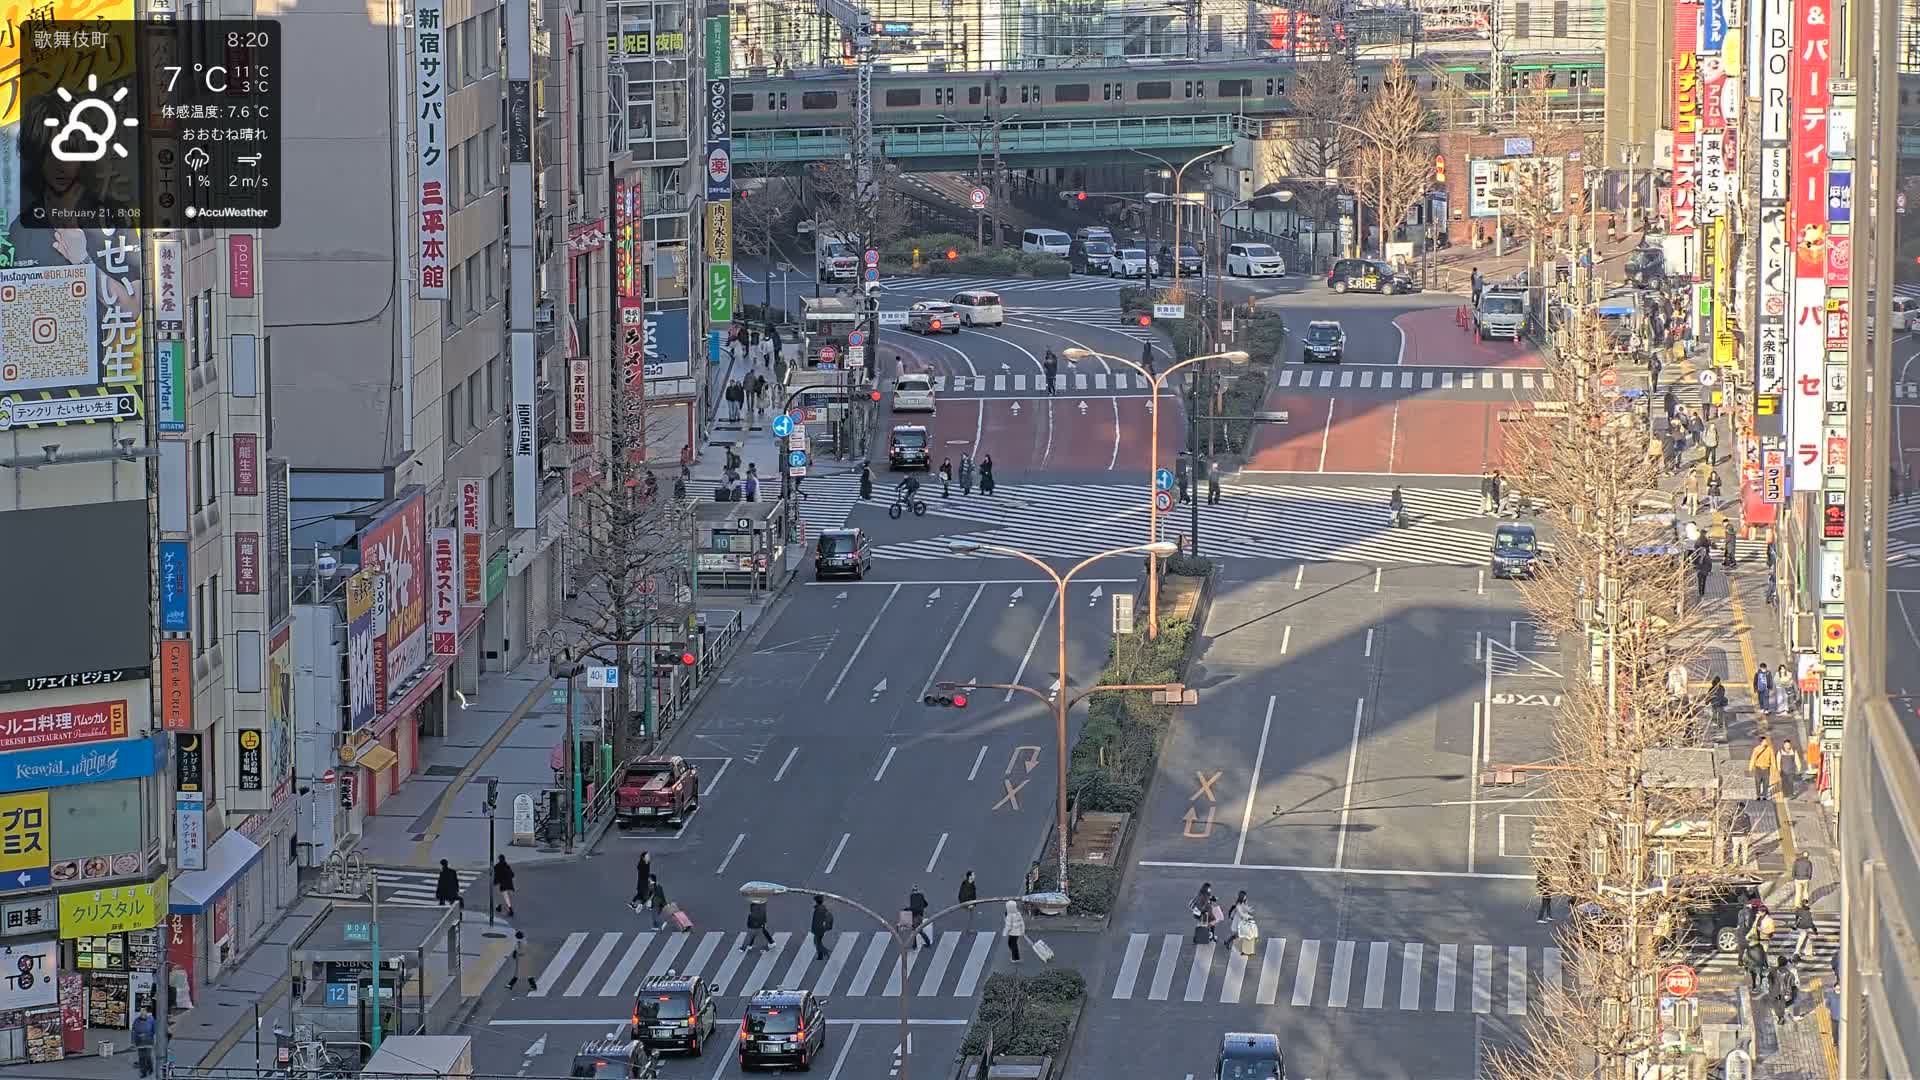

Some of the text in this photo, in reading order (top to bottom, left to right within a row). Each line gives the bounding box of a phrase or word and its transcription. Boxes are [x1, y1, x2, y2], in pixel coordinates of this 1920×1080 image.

[624, 34, 649, 52] 祝日
[656, 33, 684, 52] 夜間
[1710, 84, 1720, 116] アコム
[418, 8, 444, 288] 新宿サンパーク 三平本館
[714, 205, 726, 261] 肉汁水餃子
[0, 271, 43, 284] Instagram
[236, 244, 249, 288] partir
[713, 272, 726, 310] レイク
[161, 321, 178, 330] 3F
[624, 328, 641, 385] ラーメン
[1762, 327, 1775, 379] 大衆酒場
[160, 350, 173, 410] FamilyMart
[1797, 305, 1822, 466] パセラ
[17, 401, 114, 419] テンクリ たいせい先生
[1831, 403, 1845, 411] 5F
[517, 403, 532, 457] HOMEGAME
[464, 484, 475, 528] GAME
[164, 551, 176, 603] ゲウチャイ
[436, 539, 452, 626] 三平ストア
[443, 645, 455, 653] B2
[73, 712, 109, 725] パムッカレ
[113, 708, 122, 732] 5F
[28, 732, 73, 745] RESTAURANT
[2, 807, 42, 833] プロ
[3, 832, 43, 855] ミス
[7, 907, 42, 928] 囲碁
[73, 899, 145, 924] クリスタル
[329, 988, 344, 1001] 12
